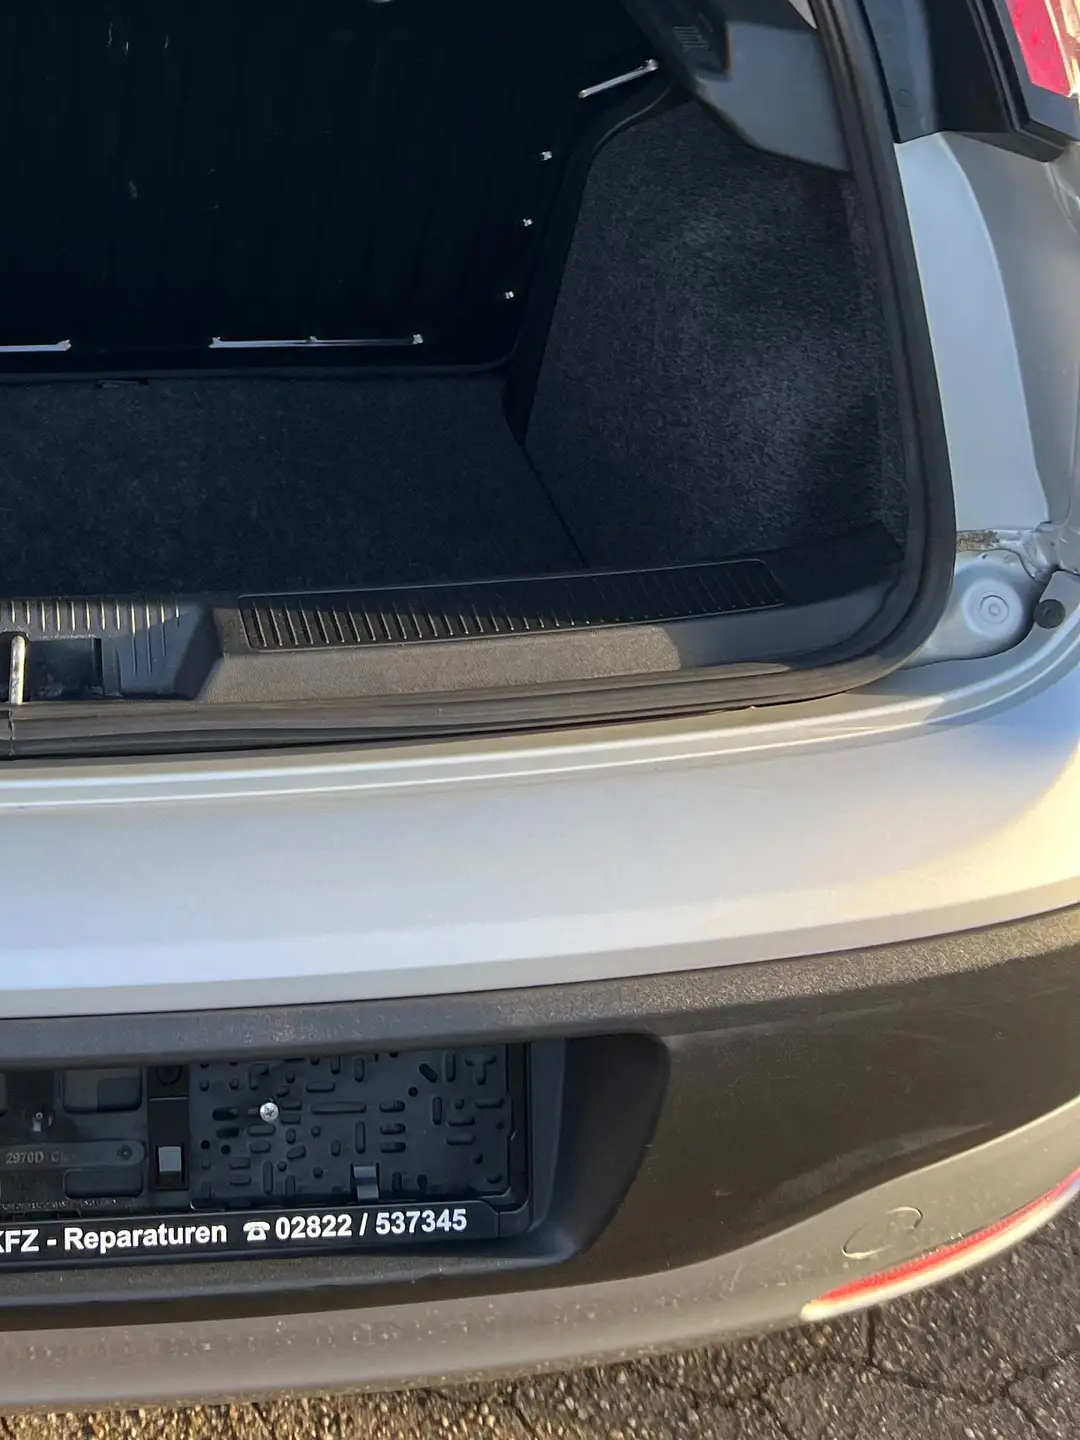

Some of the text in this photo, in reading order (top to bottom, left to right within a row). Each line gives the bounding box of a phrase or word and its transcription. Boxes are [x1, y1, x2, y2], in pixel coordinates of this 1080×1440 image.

[65, 1222, 227, 1255] Reparaturen
[275, 1214, 353, 1240] 02822
[376, 1208, 467, 1235] 537345
